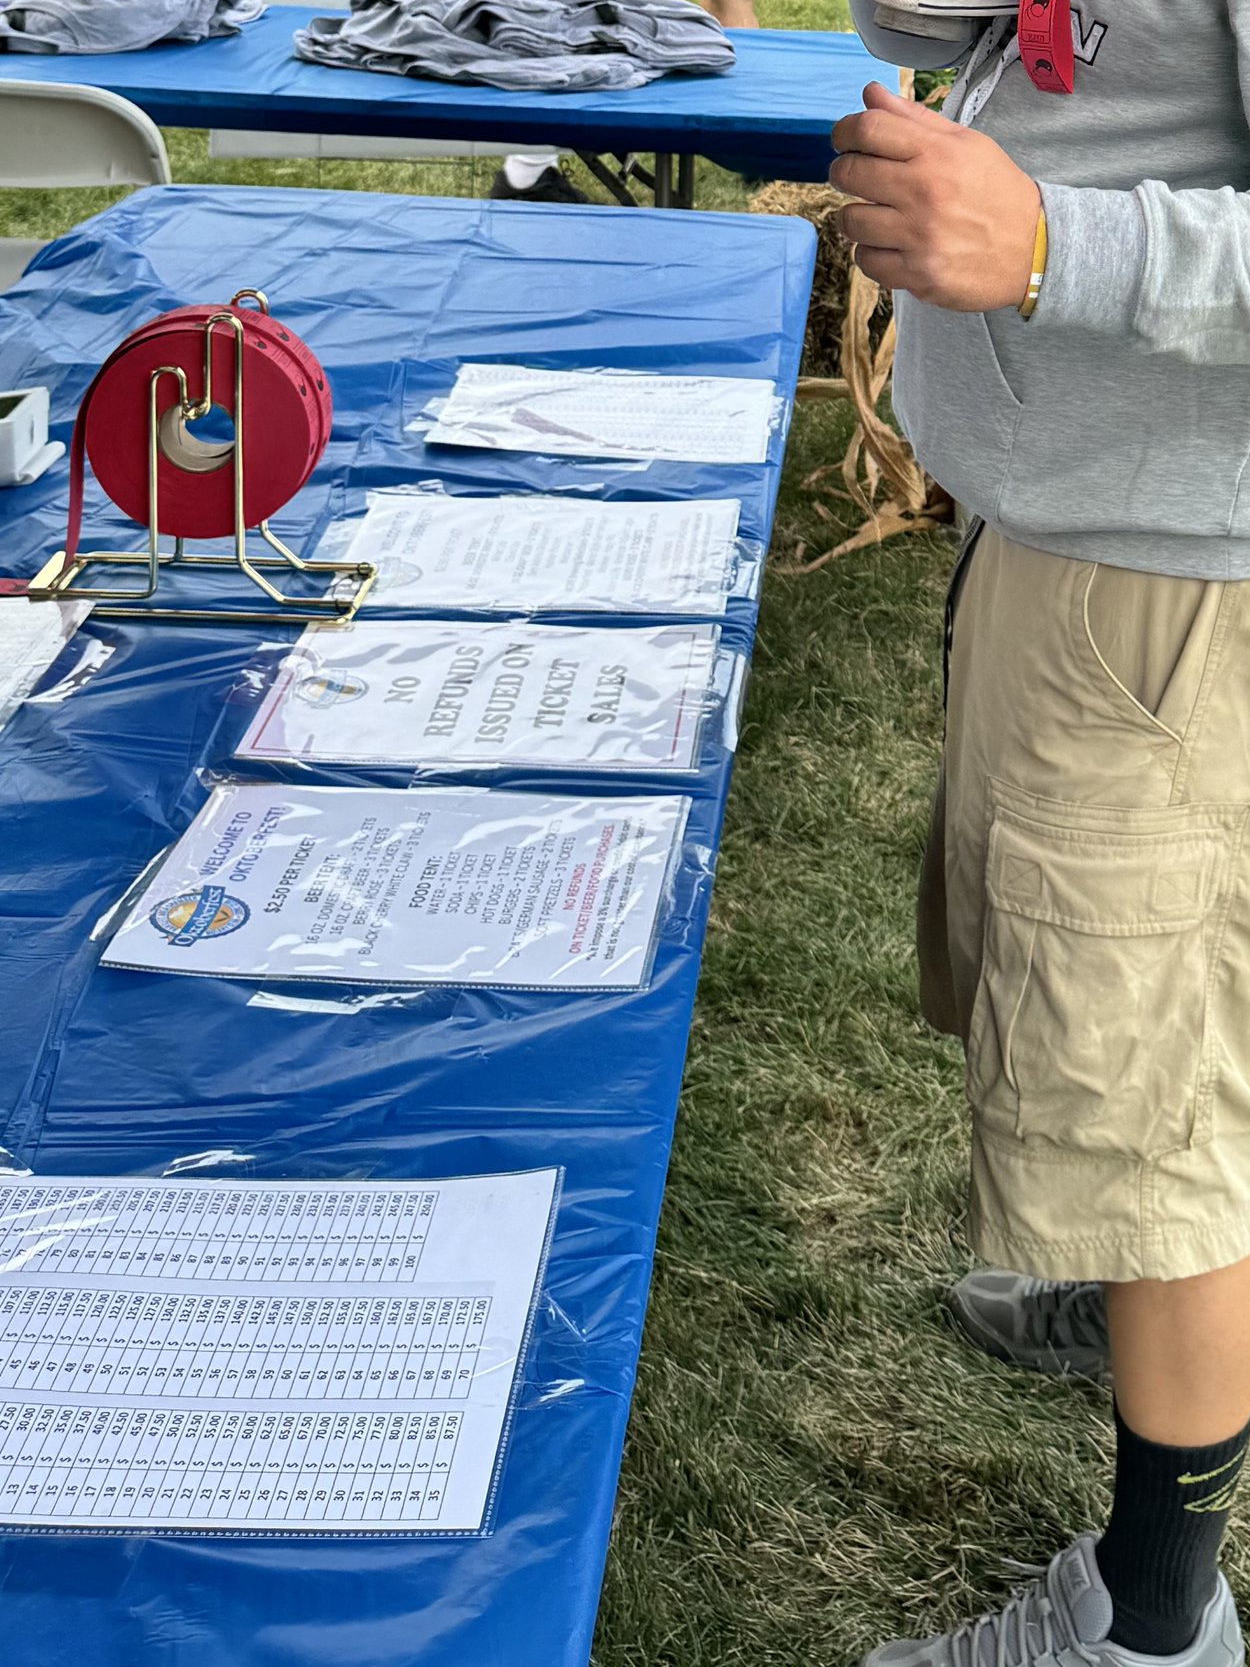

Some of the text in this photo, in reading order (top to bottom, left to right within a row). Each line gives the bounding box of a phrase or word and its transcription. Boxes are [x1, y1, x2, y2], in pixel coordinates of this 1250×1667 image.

[383, 675, 422, 703] NO
[422, 645, 486, 737] REFUNDS
[473, 642, 536, 743] ISSUED ON
[533, 657, 581, 728] TICKET
[586, 664, 628, 724] SALES
[199, 811, 253, 875] WELCOME TO
[227, 806, 286, 882] OKTOBERFEST!
[263, 836, 318, 913] $2.50 PER TICKET
[304, 853, 340, 902] BEER TENT:
[379, 838, 402, 867] TICKETS
[384, 873, 404, 896] WHITE
[394, 852, 413, 872] CLAW
[409, 855, 442, 907] FOOD TENT:
[499, 845, 517, 870] TICKET
[527, 859, 548, 893] SAUSAGE
[541, 878, 563, 915] PRETZELS
[555, 836, 575, 865] TICKETS
[329, 925, 344, 934] 16
[352, 868, 371, 886] BEER
[426, 887, 447, 914] WATER
[442, 851, 461, 875] TICKET
[446, 891, 464, 913] SODA
[458, 853, 478, 878] TICKET
[464, 891, 483, 914] CHIPS
[477, 853, 496, 878] TICKET
[481, 906, 497, 923] HOT
[487, 883, 505, 905] DOGS
[499, 888, 522, 924] BURGERS
[515, 845, 535, 875] TICKETS
[563, 862, 585, 910] NO REFUNDS
[305, 934, 320, 944] 16
[569, 941, 582, 953] ON
[354, 1257, 365, 1266] 97
[371, 1194, 386, 1216] 242.50
[371, 1257, 382, 1266] 98
[387, 1194, 402, 1216] 245.00
[387, 1257, 399, 1266] 99
[403, 1194, 418, 1216] 247.50
[404, 1255, 416, 1267] 100
[419, 1194, 434, 1216] 250.00
[316, 1370, 328, 1379] 62
[334, 1301, 351, 1325] 155.00
[334, 1370, 346, 1379] 63
[352, 1300, 368, 1324] 157.50
[352, 1370, 363, 1380] 64
[369, 1300, 385, 1325] 160.00
[369, 1370, 381, 1380] 65
[386, 1300, 402, 1324] 162.50
[387, 1370, 399, 1380] 66
[403, 1301, 419, 1324] 165.00
[405, 1370, 416, 1380] 67
[421, 1301, 436, 1325] 167.50
[423, 1370, 434, 1380] 68
[437, 1301, 453, 1325] 170.00
[440, 1369, 452, 1379] 69
[455, 1300, 470, 1324] 172.50
[458, 1369, 469, 1379] 70
[472, 1300, 487, 1324] 175.00
[257, 1489, 270, 1500] 26
[278, 1416, 295, 1439] 65.00
[276, 1489, 288, 1500] 27
[296, 1416, 313, 1439] 67.50
[295, 1489, 308, 1500] 28
[314, 1416, 331, 1439] 70.00
[314, 1490, 327, 1500] 29
[333, 1416, 349, 1439] 72.50
[332, 1489, 345, 1501] 30
[351, 1416, 367, 1440] 75.00
[351, 1490, 364, 1501] 31
[369, 1416, 385, 1440] 77.50
[371, 1490, 383, 1501] 32
[388, 1416, 404, 1440] 80.00
[390, 1490, 402, 1501] 33
[406, 1416, 422, 1439] 82.50
[408, 1490, 420, 1501] 34
[424, 1416, 440, 1439] 85.00
[427, 1490, 440, 1500] 35
[443, 1415, 458, 1439] 87.50
